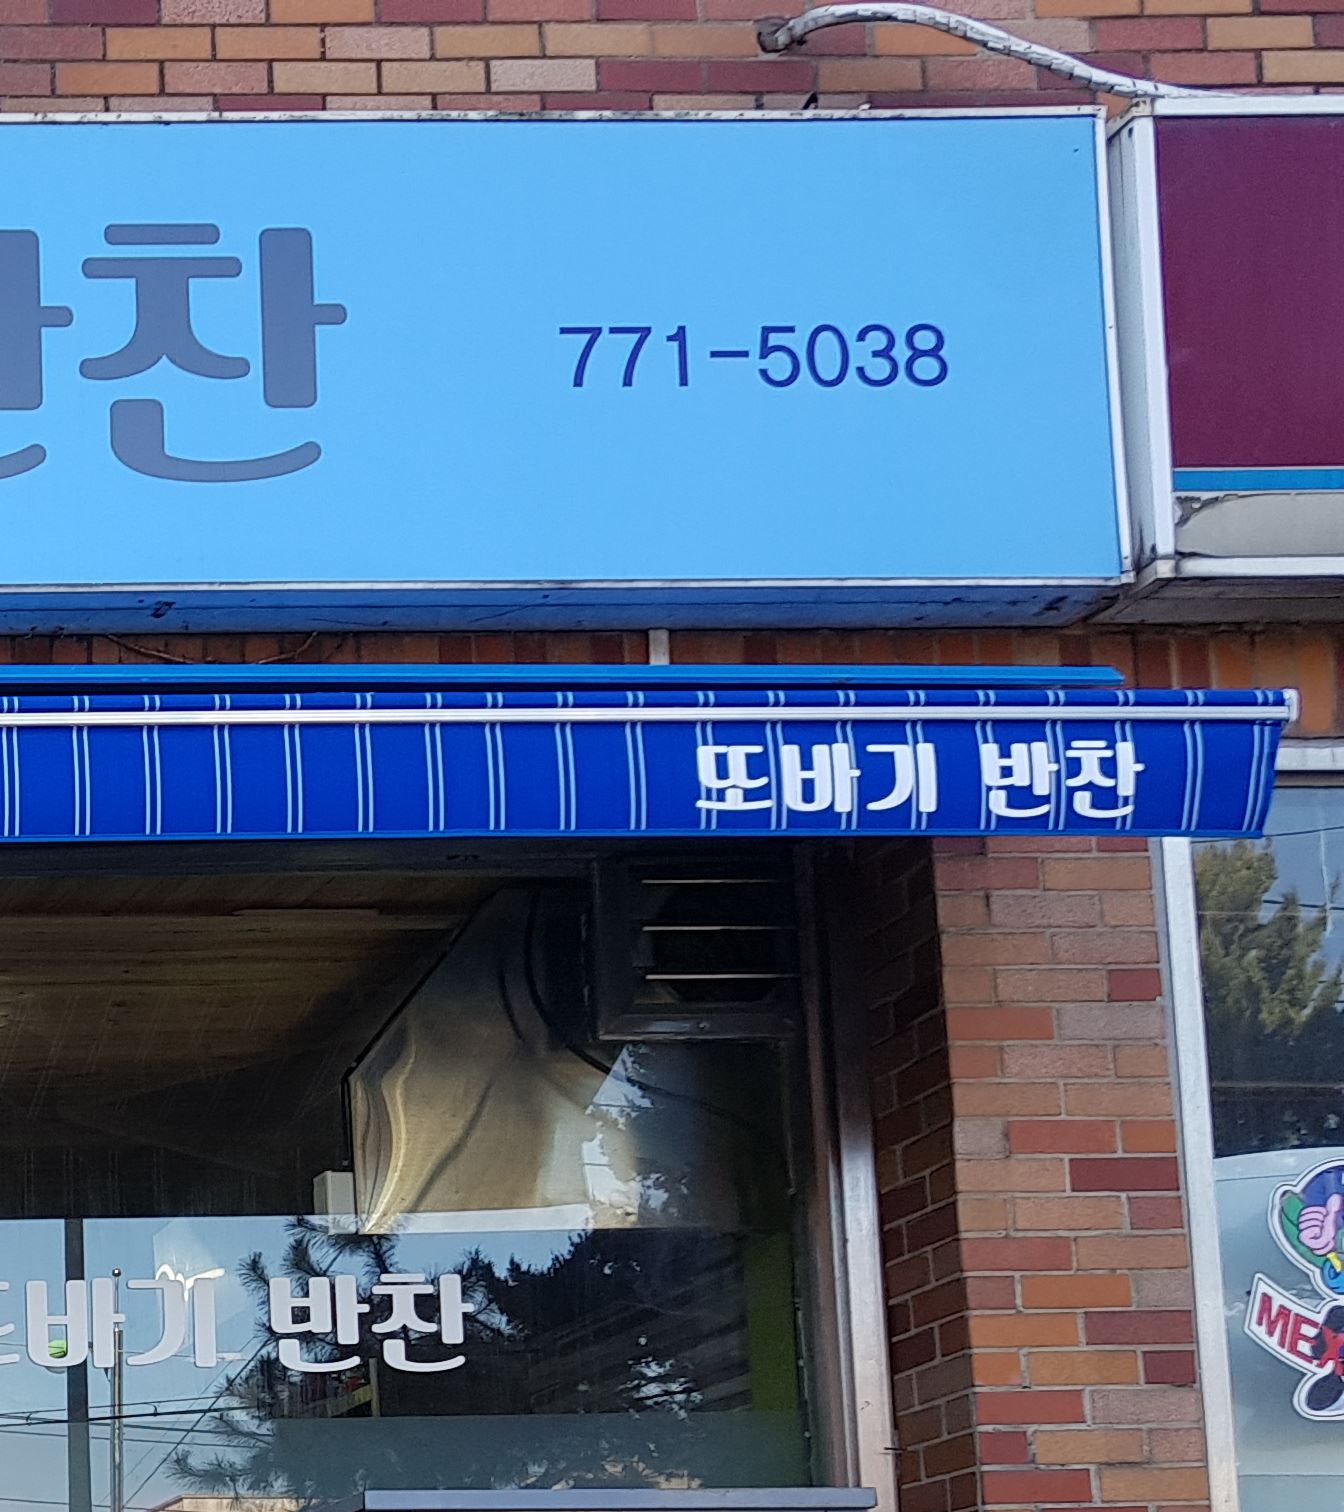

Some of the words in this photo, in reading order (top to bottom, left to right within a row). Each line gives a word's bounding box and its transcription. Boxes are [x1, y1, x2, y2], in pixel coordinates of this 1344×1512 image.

[557, 322, 950, 388] 771-5038
[695, 741, 938, 813] 또바기
[980, 739, 1145, 818] 반찬
[268, 1272, 474, 1373] 반찬
